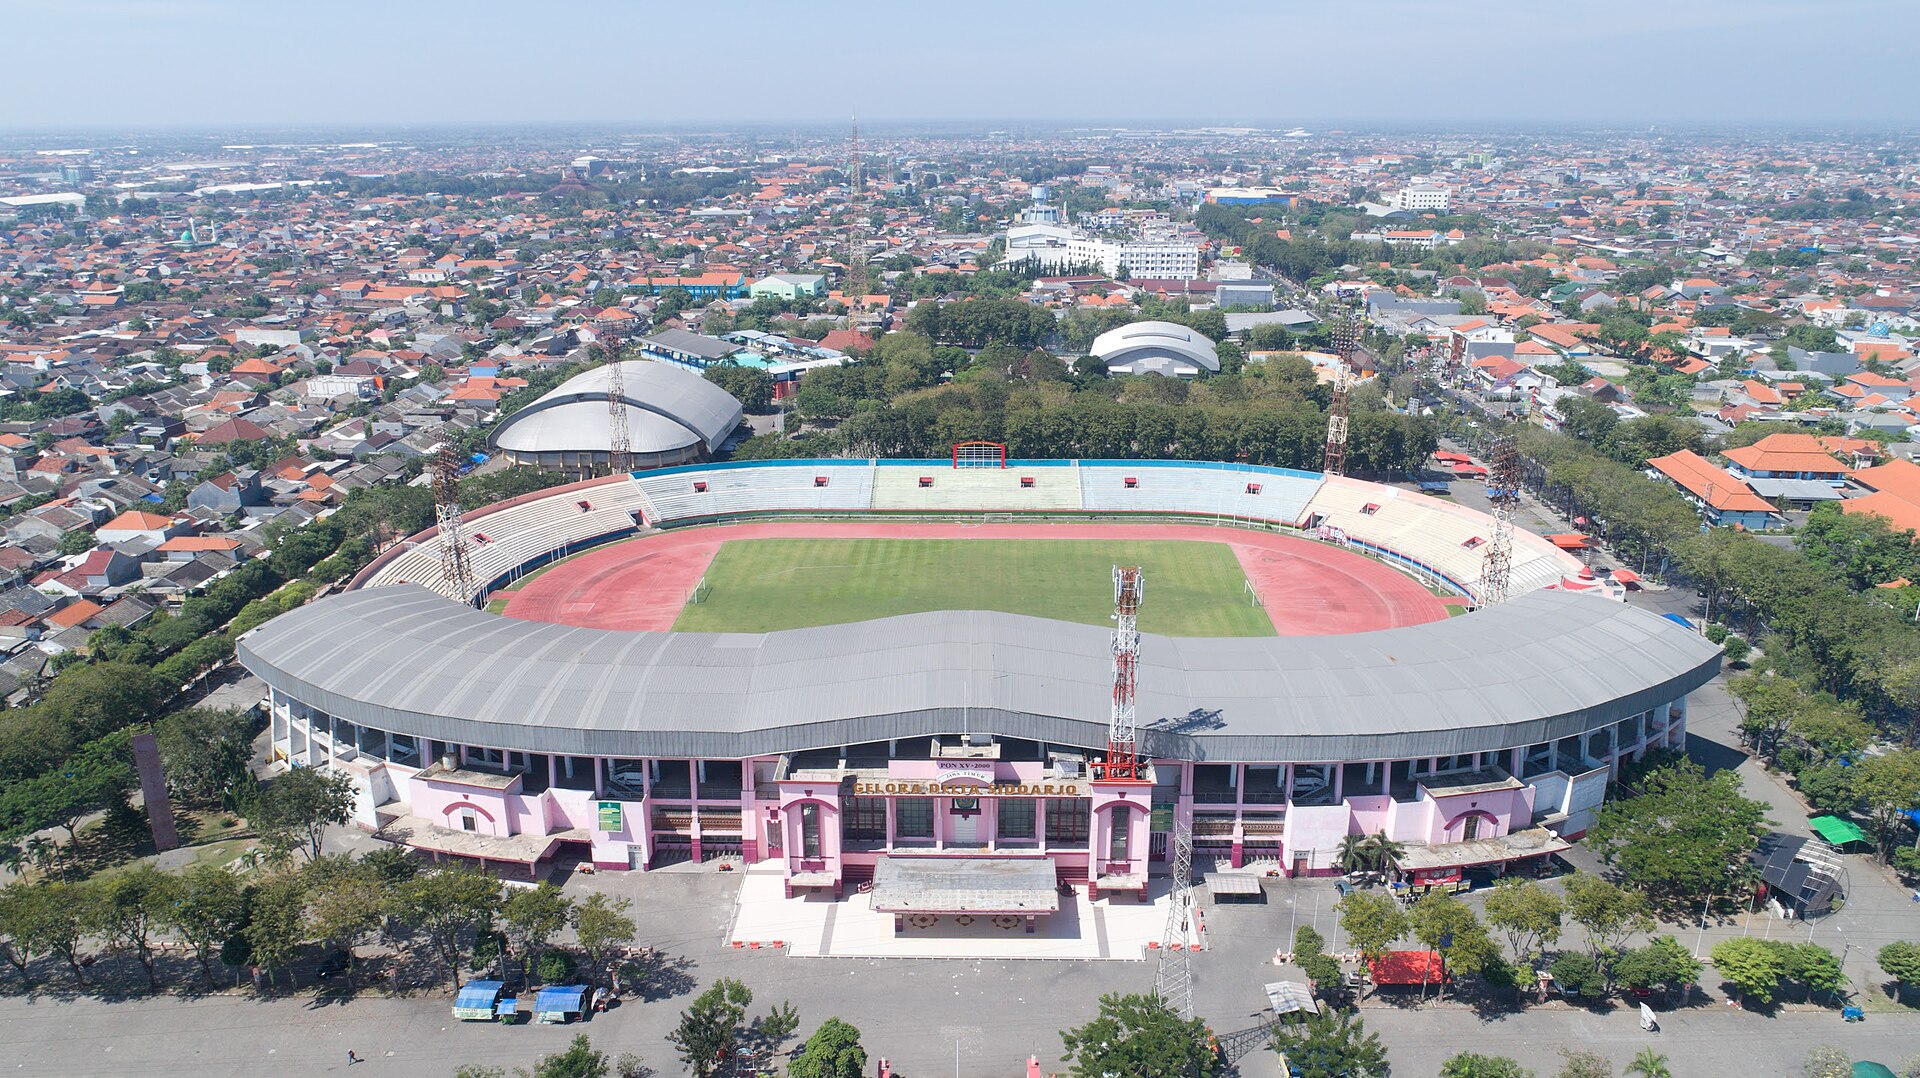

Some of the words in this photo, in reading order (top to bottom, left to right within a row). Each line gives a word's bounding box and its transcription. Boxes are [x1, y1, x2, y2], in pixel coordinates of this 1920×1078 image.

[853, 783, 922, 794] GELORA
[929, 783, 980, 794] DELTA
[987, 783, 1077, 795] SIDOARJO
